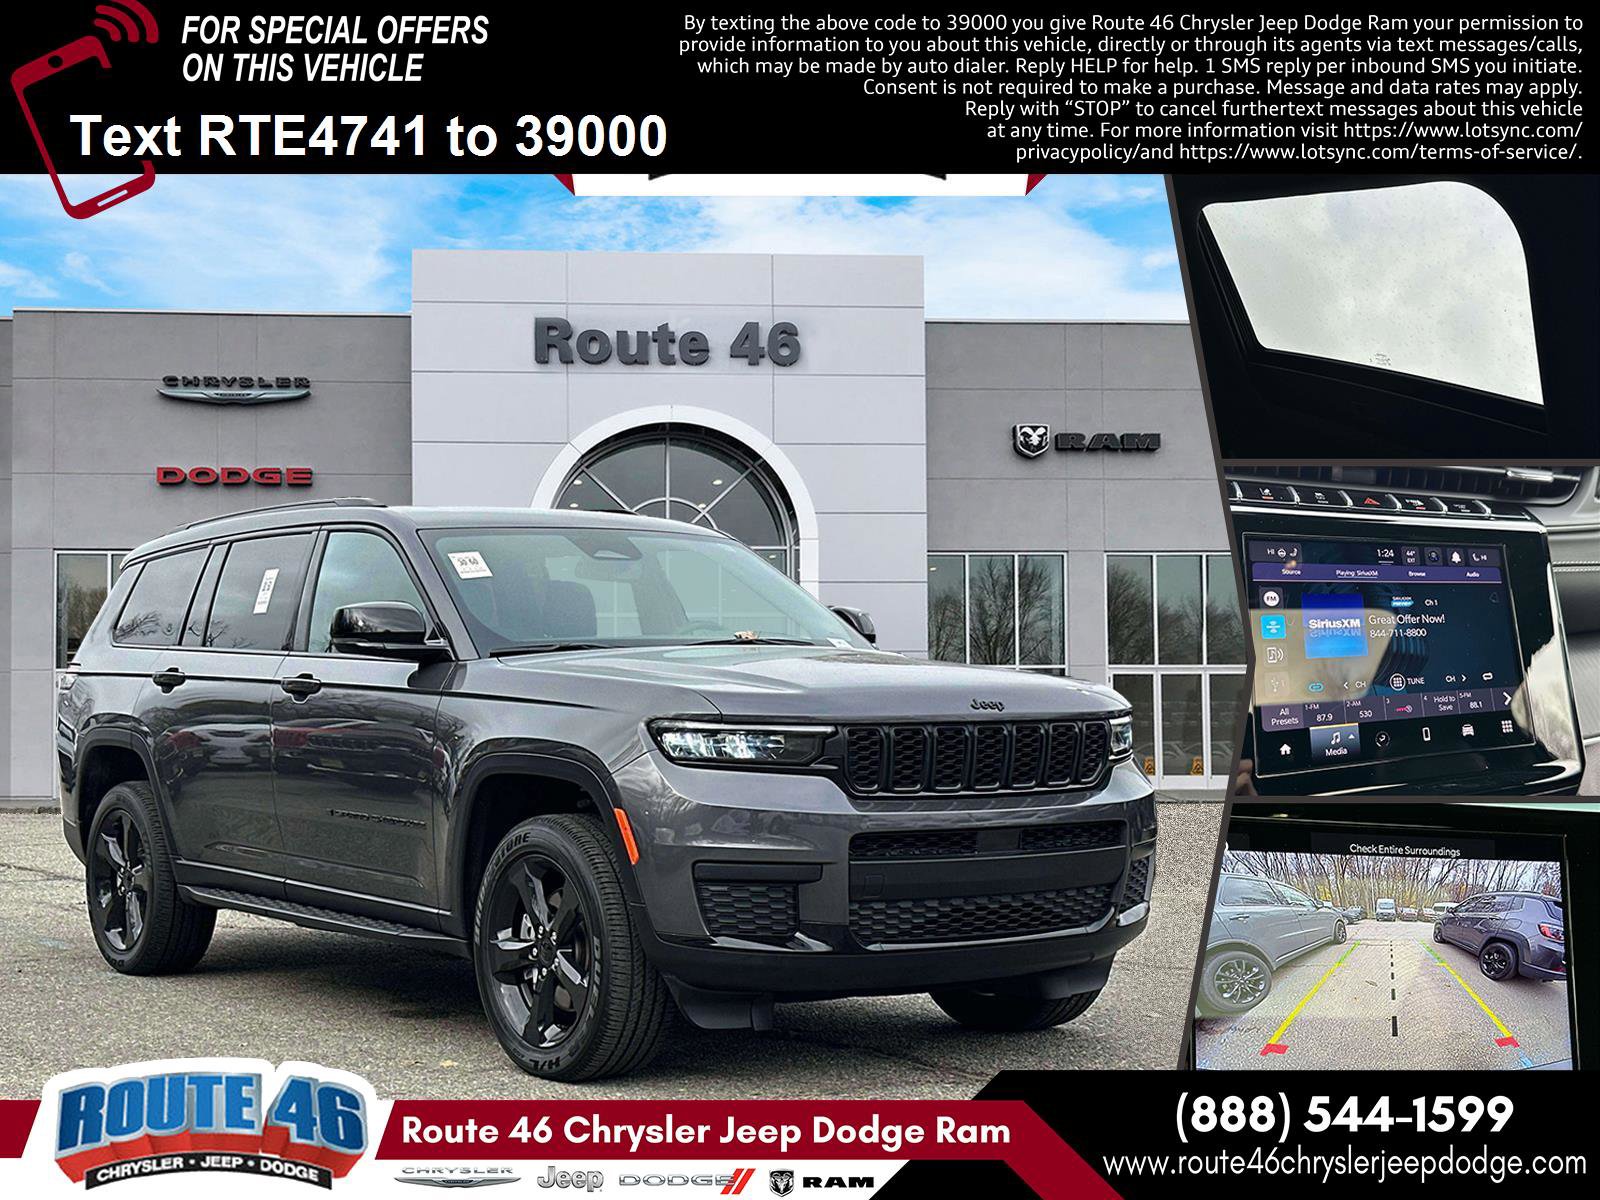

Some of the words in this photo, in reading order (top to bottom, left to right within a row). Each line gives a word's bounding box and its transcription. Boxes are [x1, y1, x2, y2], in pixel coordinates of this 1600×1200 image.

[534, 317, 710, 366] Route
[730, 321, 801, 367] 46
[162, 375, 310, 388] CHRYSLER
[1055, 432, 1161, 452] RAM
[156, 467, 313, 486] DODGE
[1377, 549, 1394, 557] 1:24
[1336, 569, 1355, 577] Playing
[1308, 619, 1360, 629] SiriusXM
[1369, 614, 1395, 625] Great
[1397, 614, 1420, 625] Offer
[1421, 614, 1445, 624] Now!
[1370, 628, 1427, 638] 844-711-8800
[1407, 677, 1425, 685] TUNE
[1433, 695, 1448, 703] Hold
[970, 699, 1005, 712] Jeep
[1438, 703, 1453, 711] Save
[1280, 708, 1289, 716] All
[1360, 710, 1372, 718] 530
[1271, 716, 1299, 726] Presets
[1316, 713, 1333, 722] 87.9
[1325, 747, 1348, 757] Media
[1349, 843, 1377, 854] Check
[1378, 845, 1404, 855] Entire
[1404, 846, 1461, 858] Surroundings
